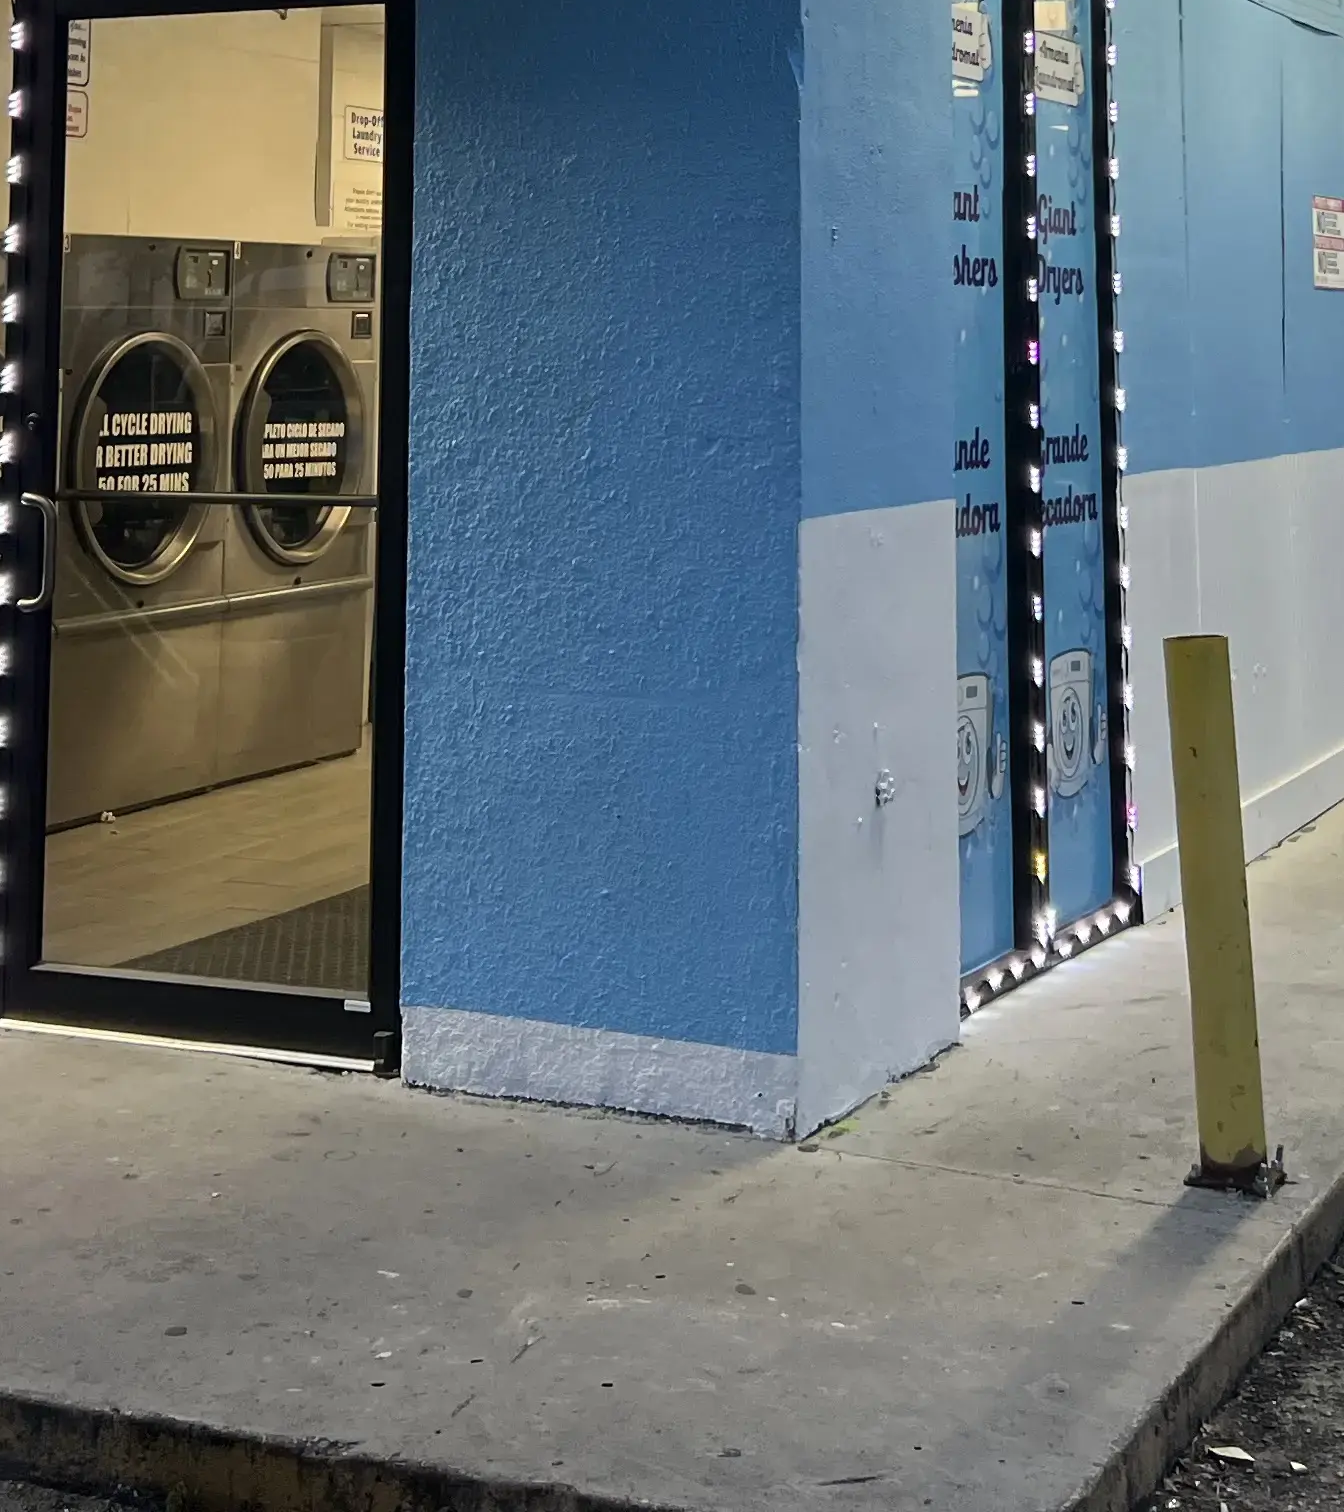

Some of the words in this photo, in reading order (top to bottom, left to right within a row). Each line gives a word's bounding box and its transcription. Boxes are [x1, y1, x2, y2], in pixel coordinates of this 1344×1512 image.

[353, 128, 382, 144] Laundry
[354, 143, 381, 157] Service
[953, 184, 980, 222] ant
[1036, 194, 1077, 244] Giant
[953, 244, 998, 287] shers
[1036, 253, 1084, 305] Dryers
[111, 413, 148, 436] CYCLE
[149, 412, 192, 435] DRYING
[105, 444, 148, 467] BETTER
[149, 442, 193, 465] DRYING
[1039, 423, 1089, 478] rande
[117, 474, 140, 491] FOR
[141, 473, 158, 491] 25
[159, 471, 190, 492] MINS
[275, 463, 294, 478] PARA
[294, 462, 305, 477] 25
[1041, 484, 1098, 527] ecadora
